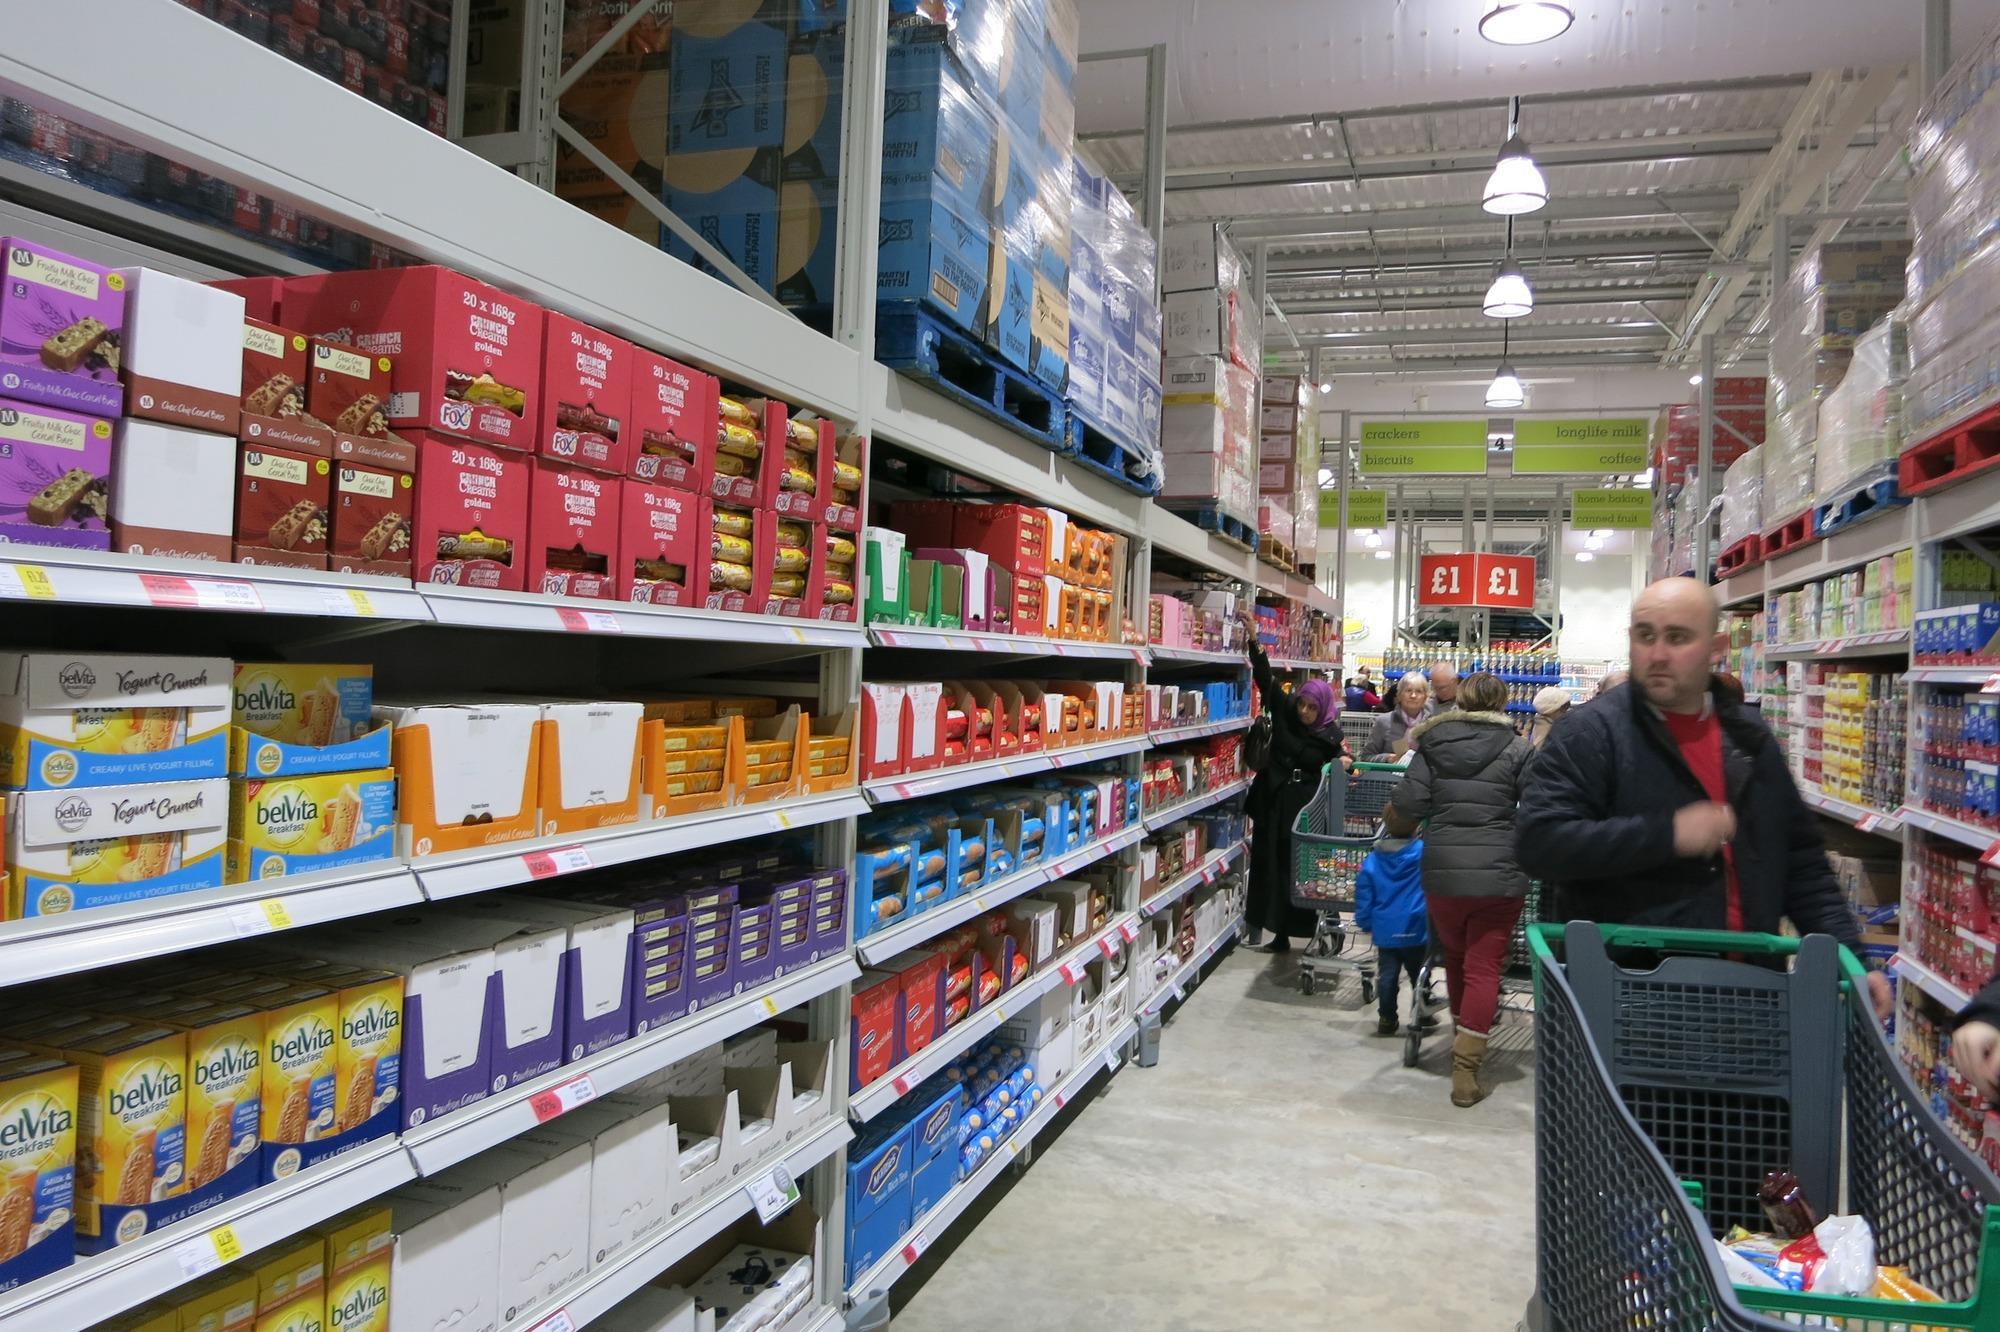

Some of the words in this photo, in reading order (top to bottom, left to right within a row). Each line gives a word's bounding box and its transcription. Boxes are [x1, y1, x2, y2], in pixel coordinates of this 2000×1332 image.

[36, 259, 60, 275] Fruity
[61, 267, 77, 280] Milk
[78, 272, 96, 284] Choc
[45, 274, 69, 289] Cereal
[69, 281, 88, 294] Bars
[463, 291, 477, 308] 20
[479, 300, 488, 313] x
[491, 303, 517, 326] 168g
[474, 341, 503, 356] golden
[571, 331, 582, 346] 20
[593, 341, 613, 361] 168g
[23, 379, 45, 396] Fruity
[580, 376, 602, 389] golden
[22, 416, 46, 432] Fruity
[47, 421, 64, 434] Milk
[64, 423, 81, 436] Choc
[1365, 428, 1420, 439] crackers
[1556, 426, 1608, 440] longlife
[1612, 425, 1642, 437] milk
[31, 429, 56, 443] Cereal
[56, 433, 73, 446] Bars
[1495, 437, 1506, 450] 4
[451, 450, 465, 465] 20
[468, 455, 476, 466] x
[479, 456, 504, 477] 168g
[1365, 455, 1414, 465] biscuits
[1600, 452, 1642, 464] coffee
[557, 474, 569, 488] 20
[580, 480, 601, 497] 168g
[464, 497, 492, 510] golden
[1577, 494, 1606, 504] home
[1608, 494, 1644, 505] baking
[1353, 514, 1381, 522] bread
[1576, 510, 1614, 522] canned
[1616, 513, 1638, 522] fruit
[1431, 566, 1460, 594] £1
[1488, 567, 1519, 597] £1
[59, 668, 97, 686] belVita
[116, 670, 162, 696] Yogurt
[161, 669, 208, 694] Crunch
[234, 679, 296, 711] belVita
[246, 711, 283, 721] Breakfast
[89, 765, 125, 774] CREAMY
[127, 763, 146, 772] LIVE
[150, 762, 183, 771] YOGURT
[184, 759, 215, 769] FILLING
[290, 755, 317, 764] CREAMY
[55, 802, 93, 819] belVita
[111, 799, 157, 825] Yogurt
[156, 791, 204, 820] Crunch
[256, 790, 319, 825] belVita
[267, 823, 305, 835] Breakfast
[485, 830, 512, 845] Custard
[85, 895, 122, 906] CREAMY
[123, 889, 143, 900] LIVE
[144, 884, 178, 897] YOGURT
[342, 1000, 400, 1040] belVita
[270, 1018, 335, 1064] belVita
[351, 1030, 389, 1048] Breakfast
[195, 1038, 260, 1086] belVita
[281, 1050, 324, 1071] Breakfast
[109, 1063, 183, 1116] belVita
[206, 1073, 248, 1094] Breakfast
[0, 1097, 73, 1147] elVita
[122, 1100, 170, 1124] Breakfast
[156, 1214, 179, 1229] MILK
[188, 1192, 224, 1214] CEREALS
[331, 1278, 387, 1327] belVita
